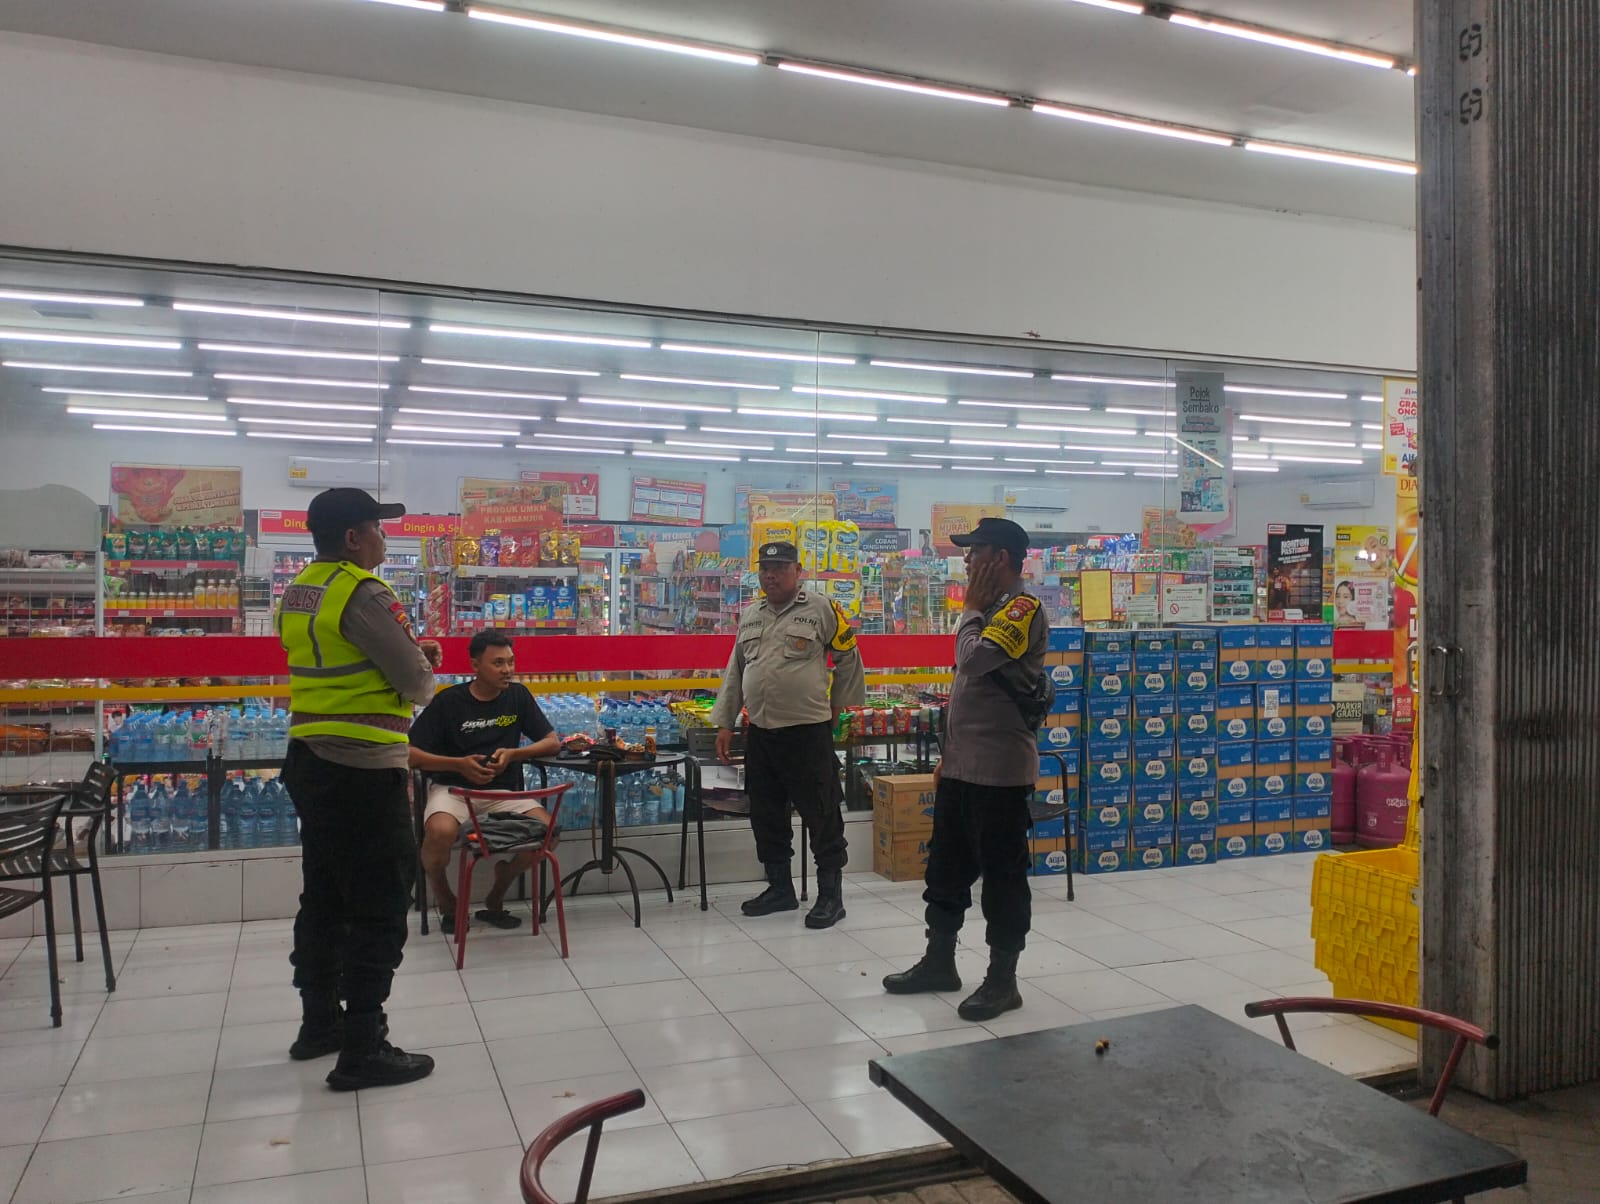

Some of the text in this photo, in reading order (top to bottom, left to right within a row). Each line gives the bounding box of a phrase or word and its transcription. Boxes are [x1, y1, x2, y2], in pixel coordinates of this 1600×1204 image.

[1190, 386, 1210, 399] Pojok
[1182, 400, 1219, 414] Sembako
[1402, 453, 1418, 462] Alf
[480, 505, 518, 514] PRODUK
[404, 523, 435, 534] Dingin
[437, 523, 446, 533] &
[793, 616, 817, 626] POLRI
[1336, 702, 1362, 711] PARKIR
[1336, 710, 1362, 718] GRATIS
[918, 791, 936, 806] AQ
